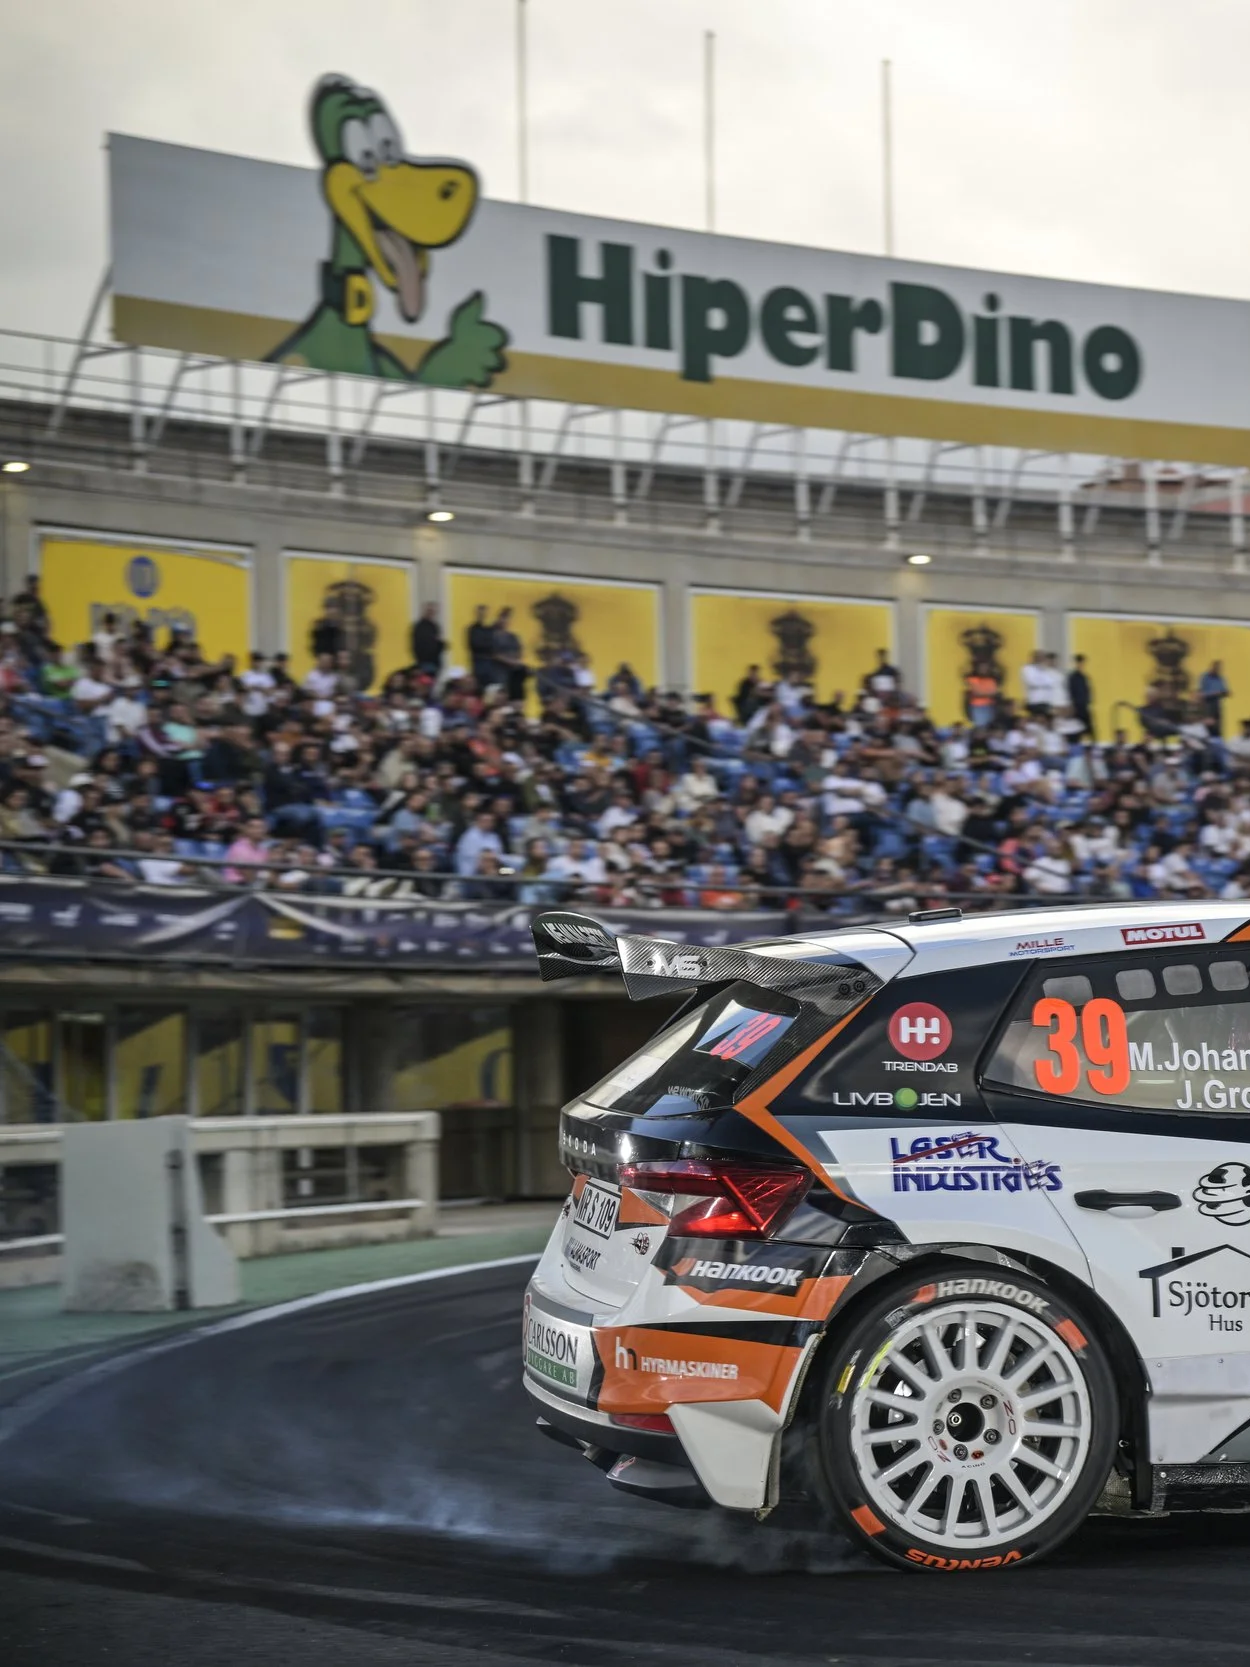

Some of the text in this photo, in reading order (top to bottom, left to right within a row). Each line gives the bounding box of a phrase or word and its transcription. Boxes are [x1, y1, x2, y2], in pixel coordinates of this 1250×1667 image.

[545, 233, 1142, 401] HiperDino
[1126, 925, 1202, 943] MOTUL
[1009, 944, 1076, 957] MOTORSPORT
[1016, 937, 1064, 951] MILLE
[1031, 997, 1131, 1095] 39
[882, 1060, 959, 1073] TRENDAB
[889, 1131, 1013, 1166] LASER
[1209, 1314, 1244, 1333] Hus
[528, 1318, 579, 1365] CARLSSON
[563, 1370, 575, 1384] AB
[641, 1356, 739, 1380] HYRMASKINER
